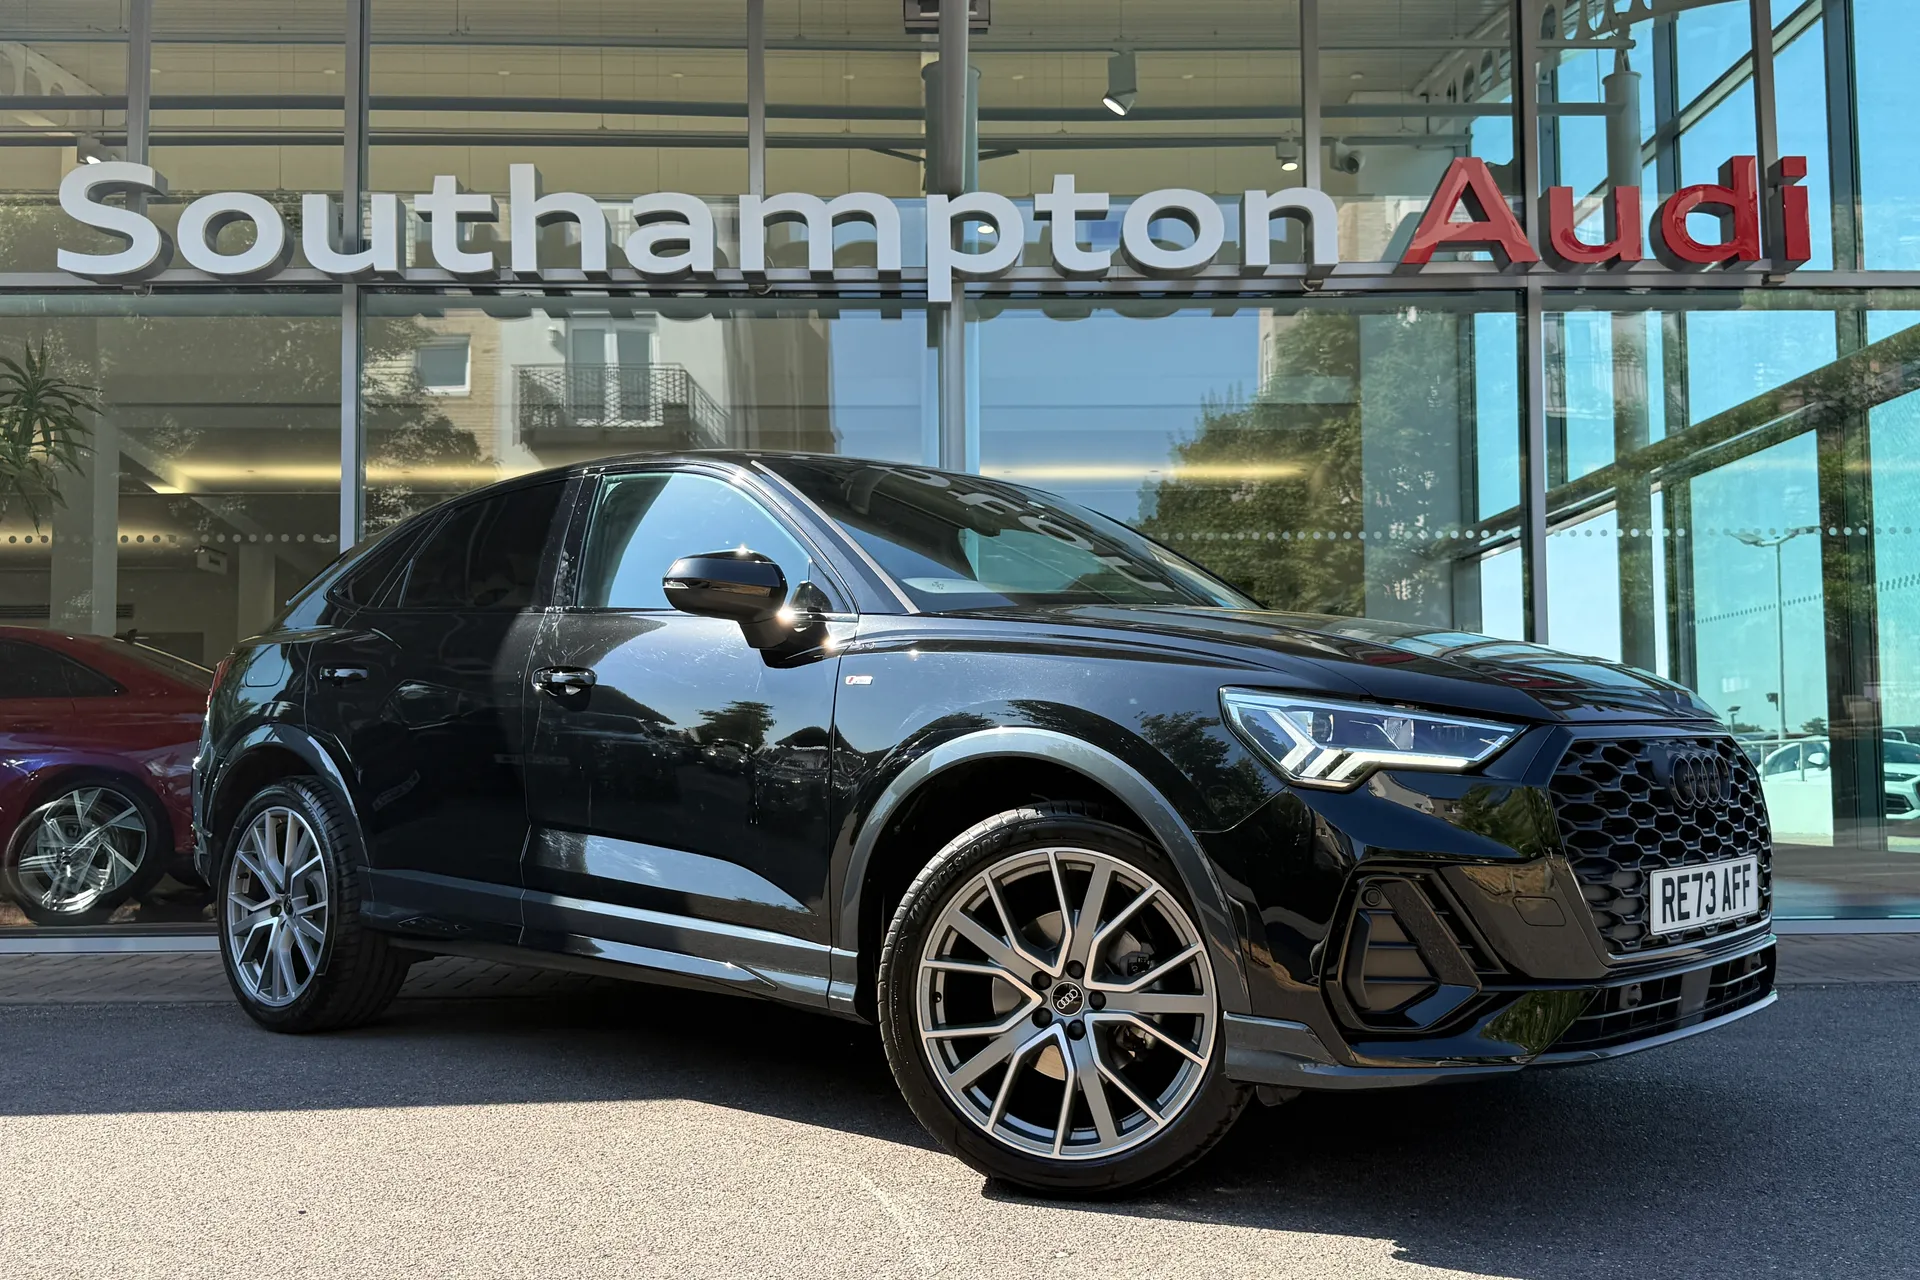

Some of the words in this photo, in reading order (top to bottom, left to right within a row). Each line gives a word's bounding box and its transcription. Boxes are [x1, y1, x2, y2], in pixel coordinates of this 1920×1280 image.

[57, 161, 1341, 303] Southampton
[1402, 155, 1811, 267] Audi
[1661, 870, 1717, 924] RE73
[1722, 863, 1752, 912] AFF
